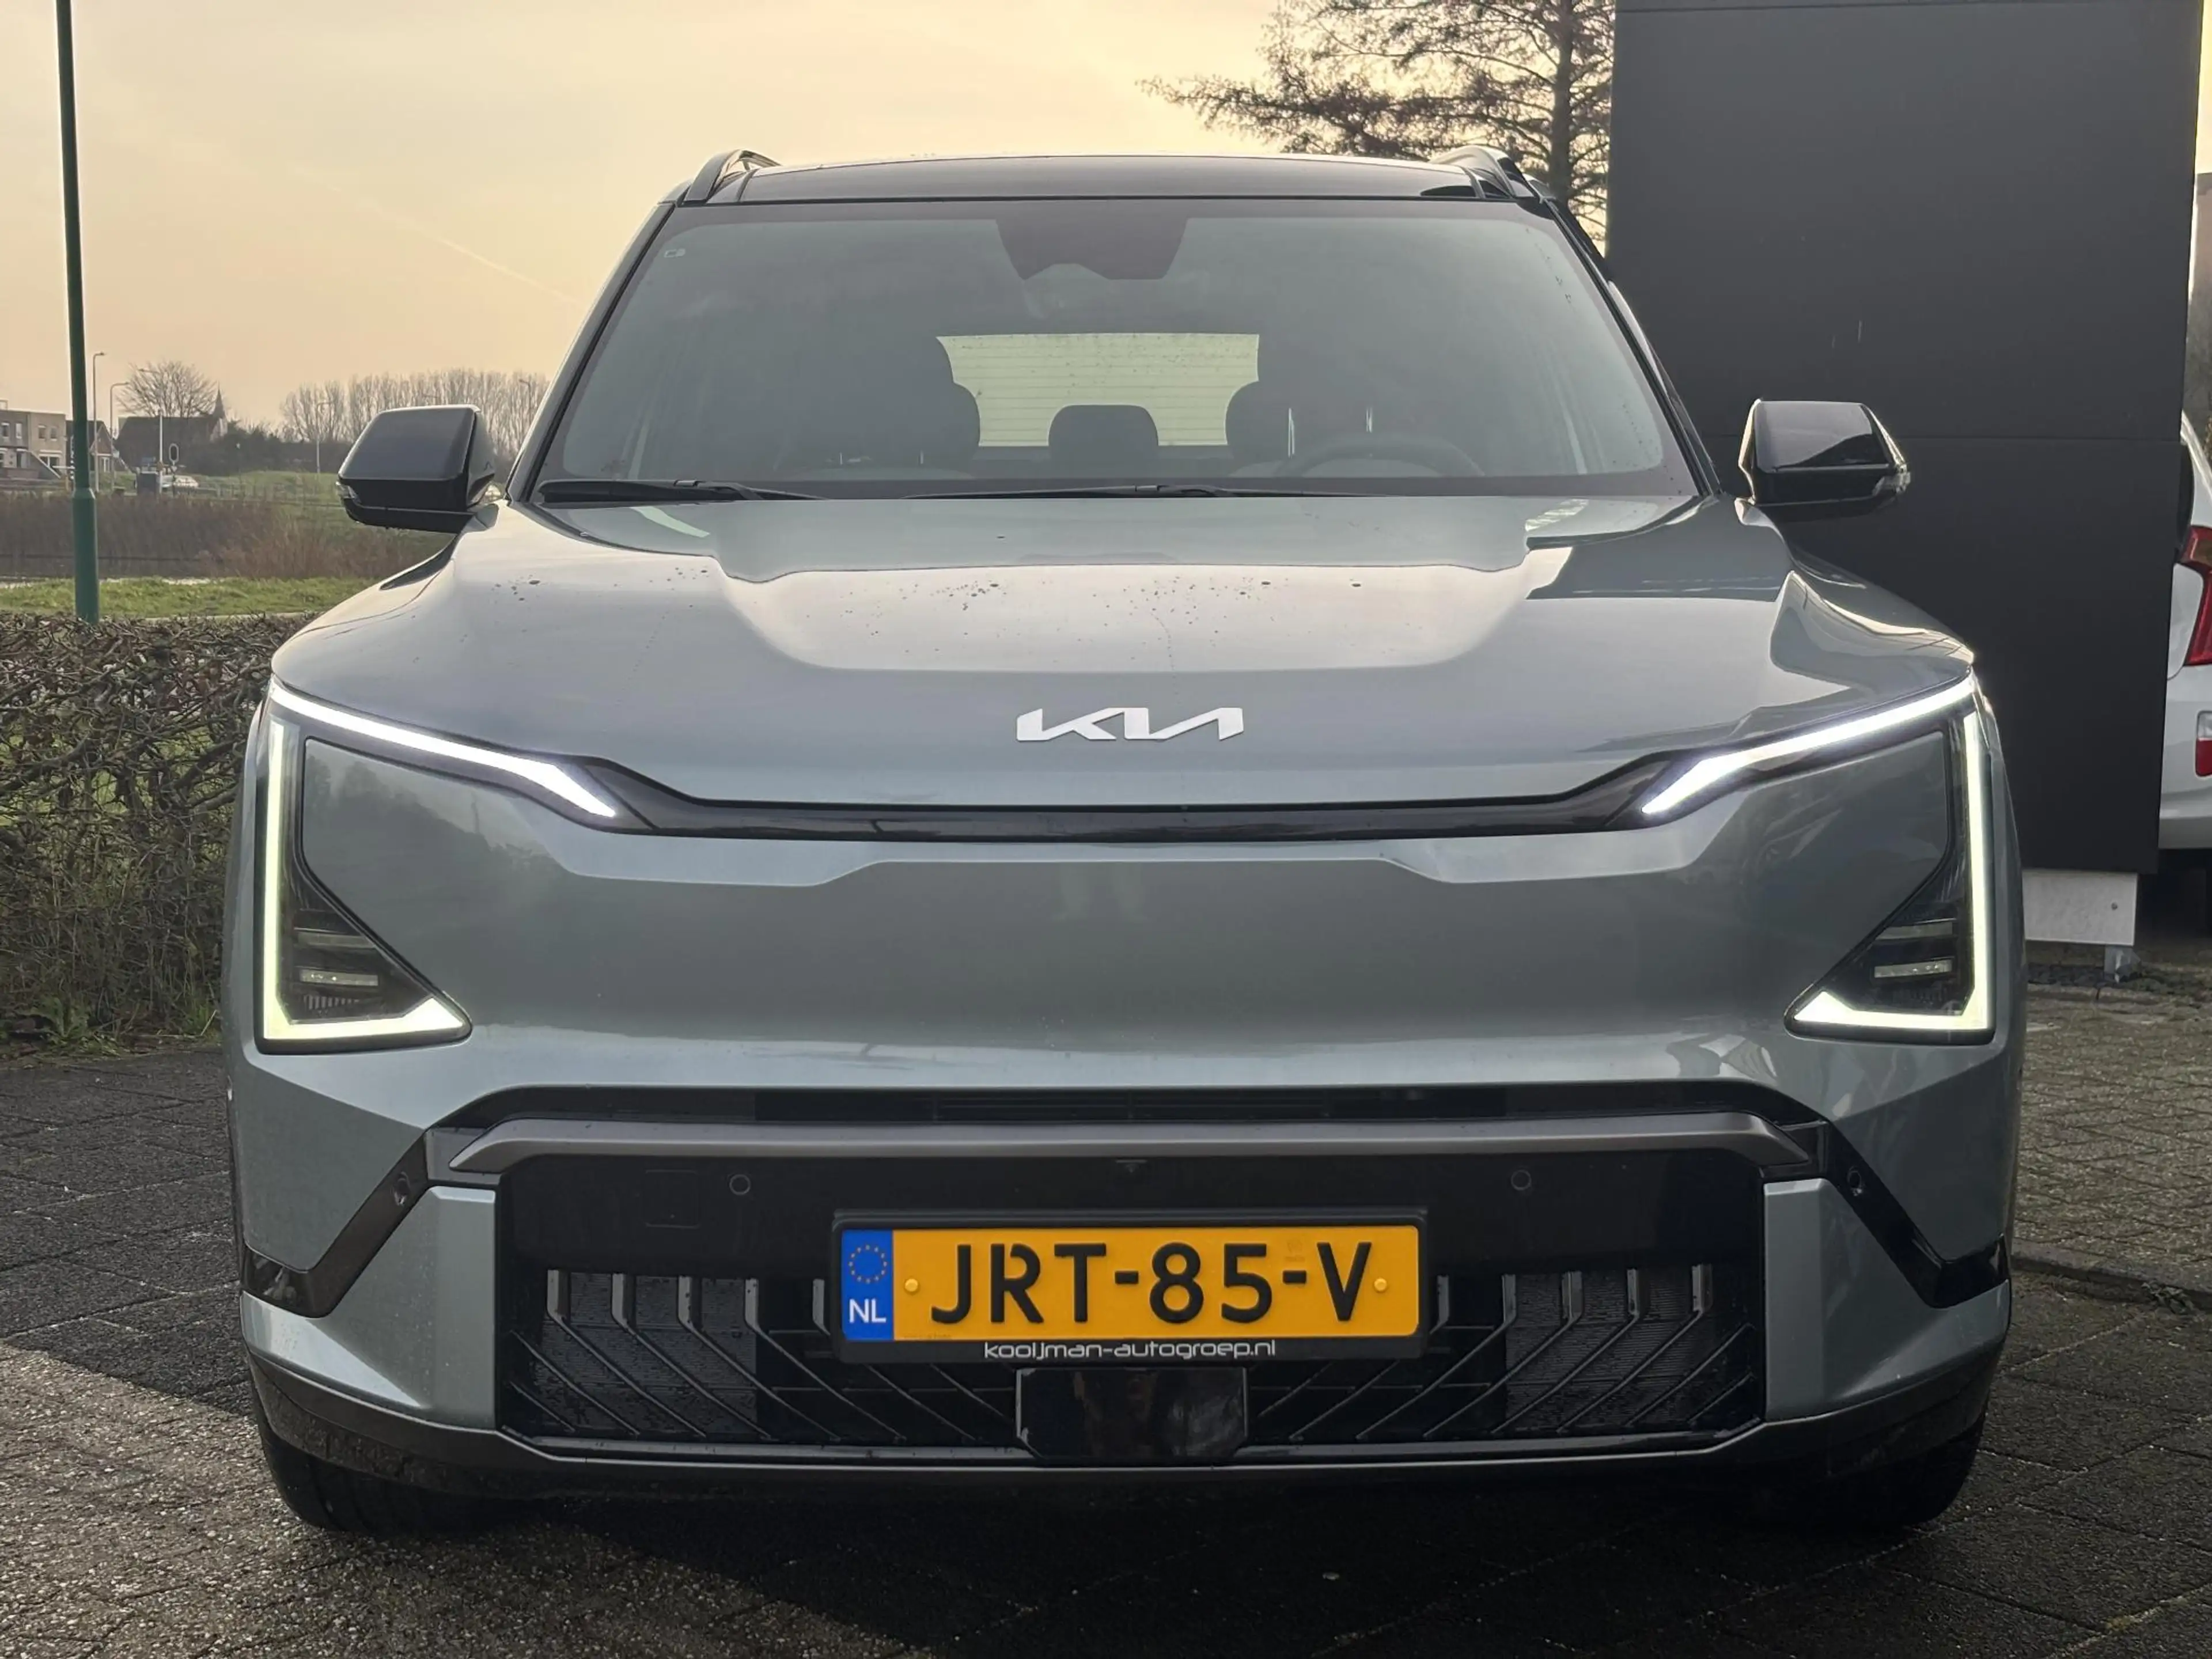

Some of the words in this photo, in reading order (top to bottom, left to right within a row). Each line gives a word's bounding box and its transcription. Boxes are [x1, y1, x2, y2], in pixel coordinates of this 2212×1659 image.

[1017, 707, 1244, 741] KIA
[931, 1243, 1372, 1324] JRT-85-V
[849, 1298, 887, 1323] NL
